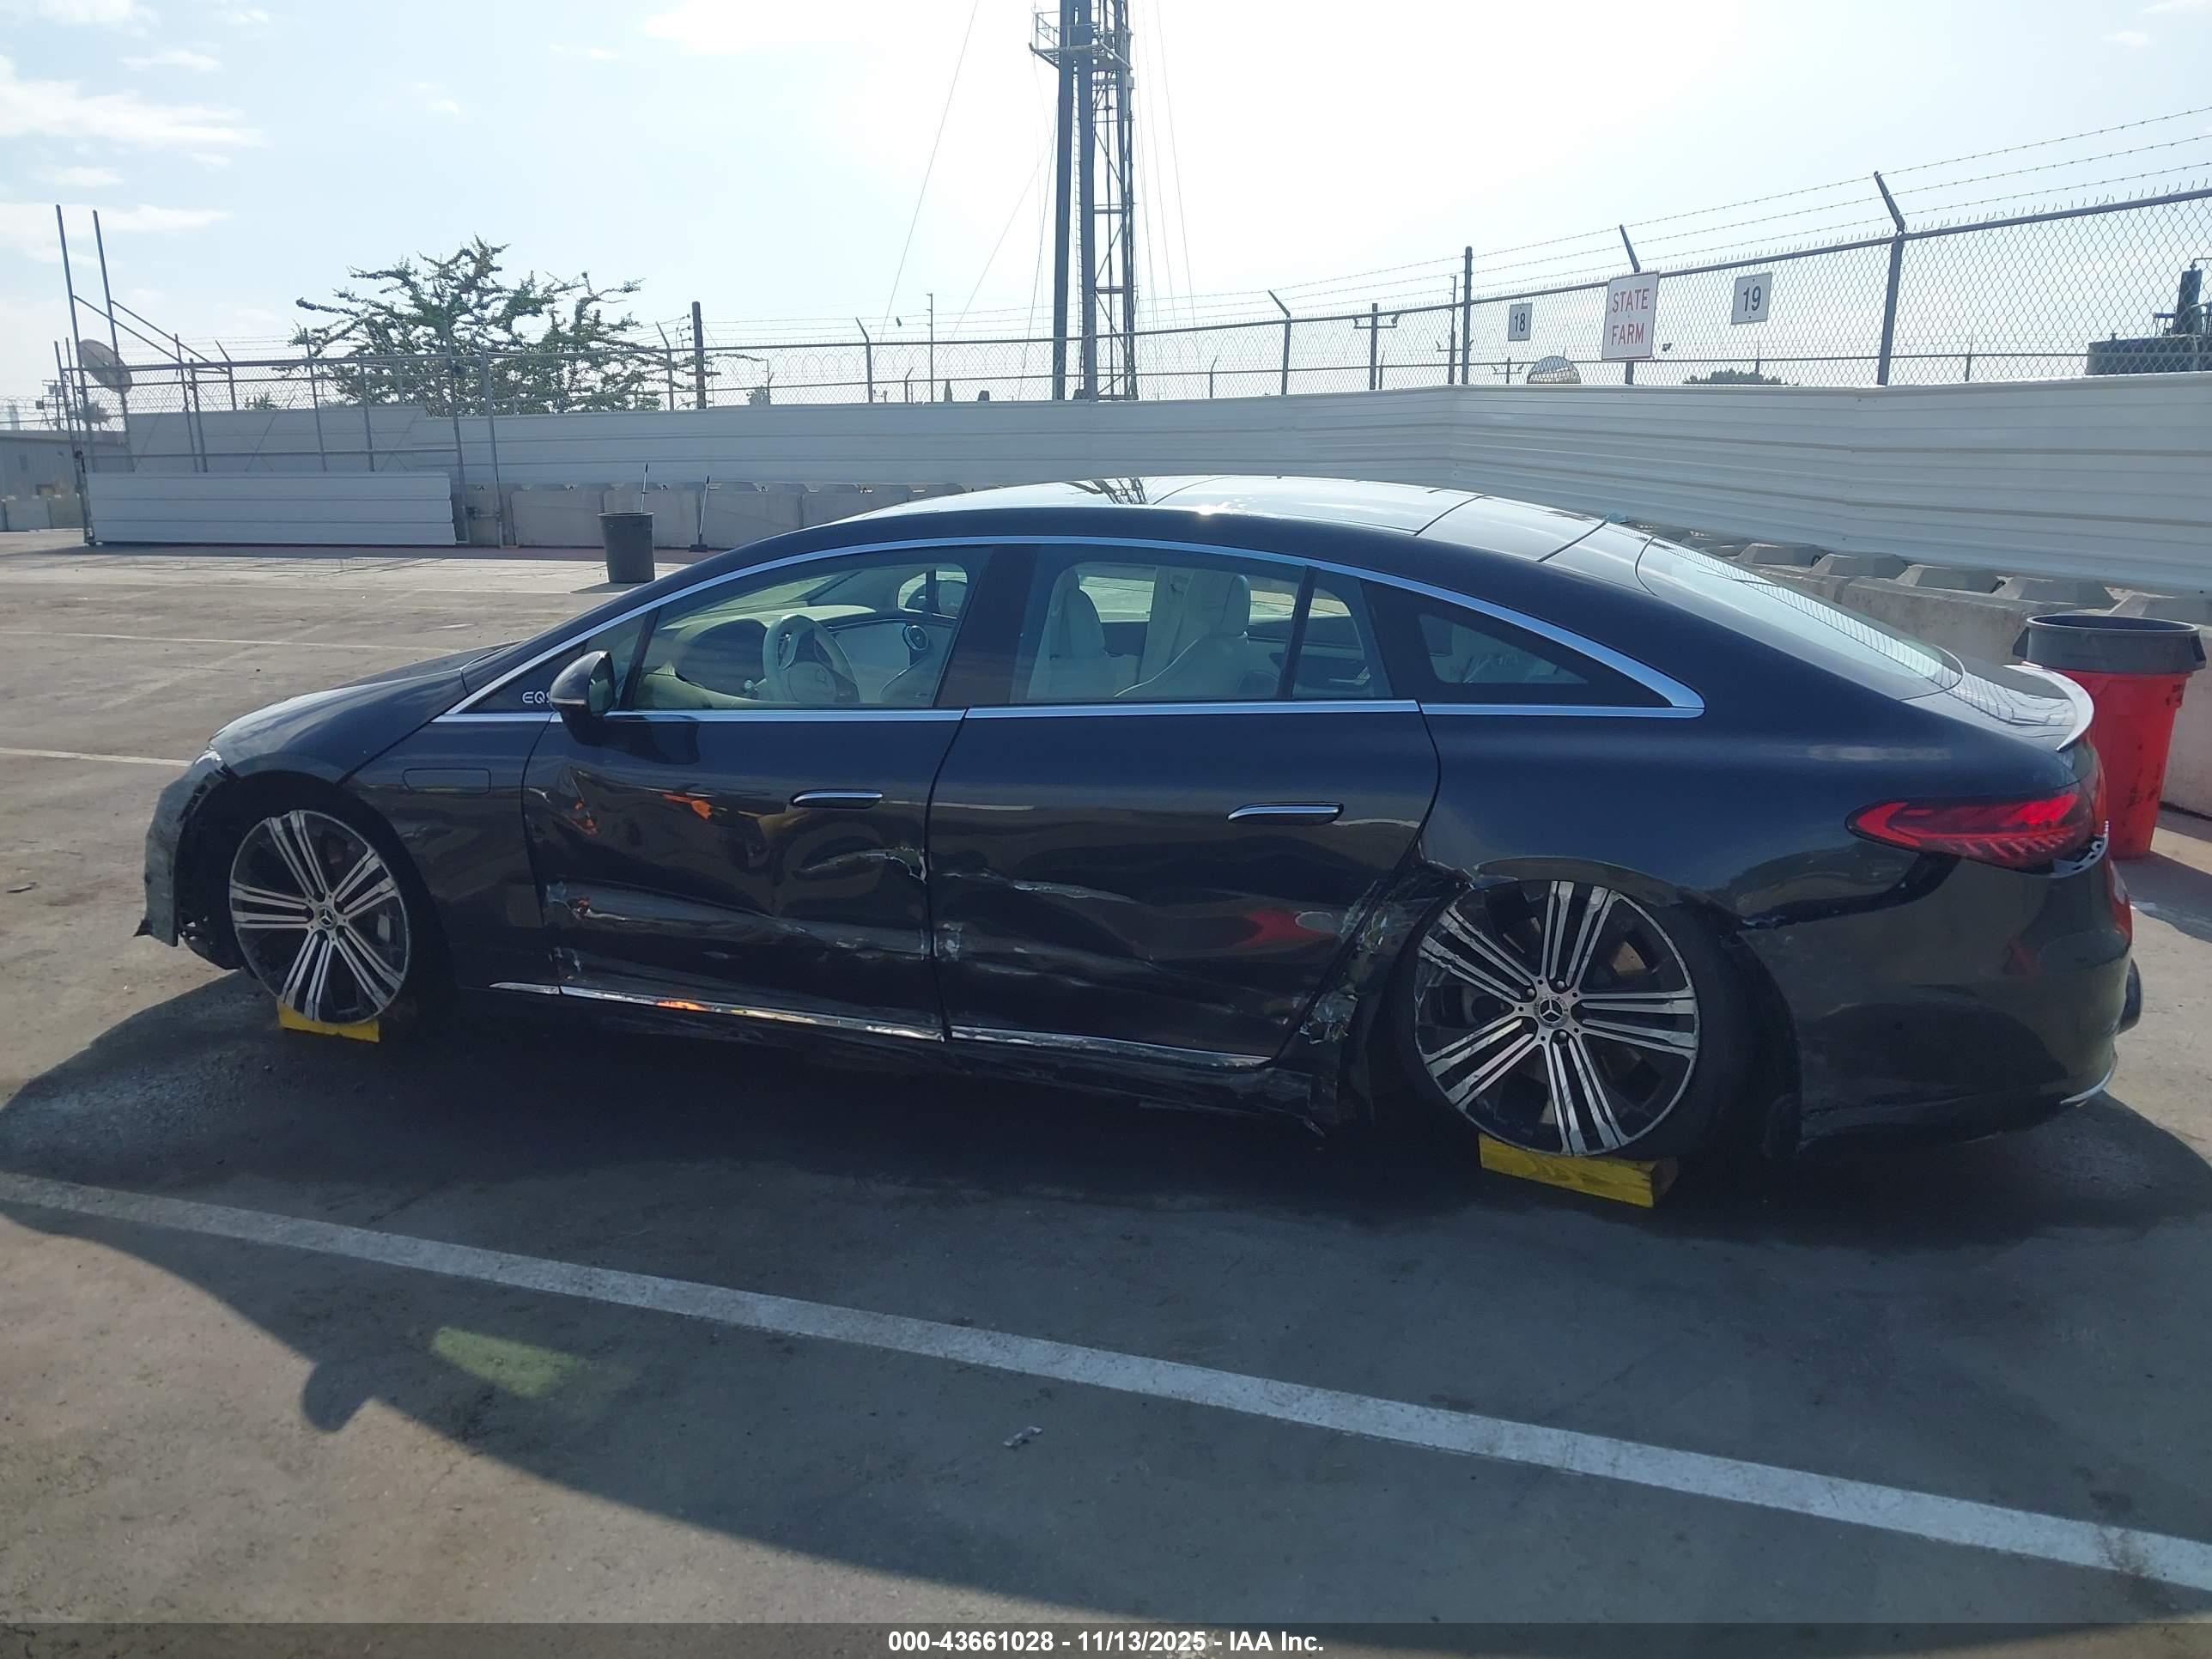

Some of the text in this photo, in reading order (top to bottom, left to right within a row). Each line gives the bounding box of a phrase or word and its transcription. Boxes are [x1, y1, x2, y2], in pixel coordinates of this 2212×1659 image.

[1612, 288, 1650, 313] STATE
[1742, 286, 1762, 312] 19
[1514, 313, 1526, 332] 18
[1611, 323, 1645, 345] FARM
